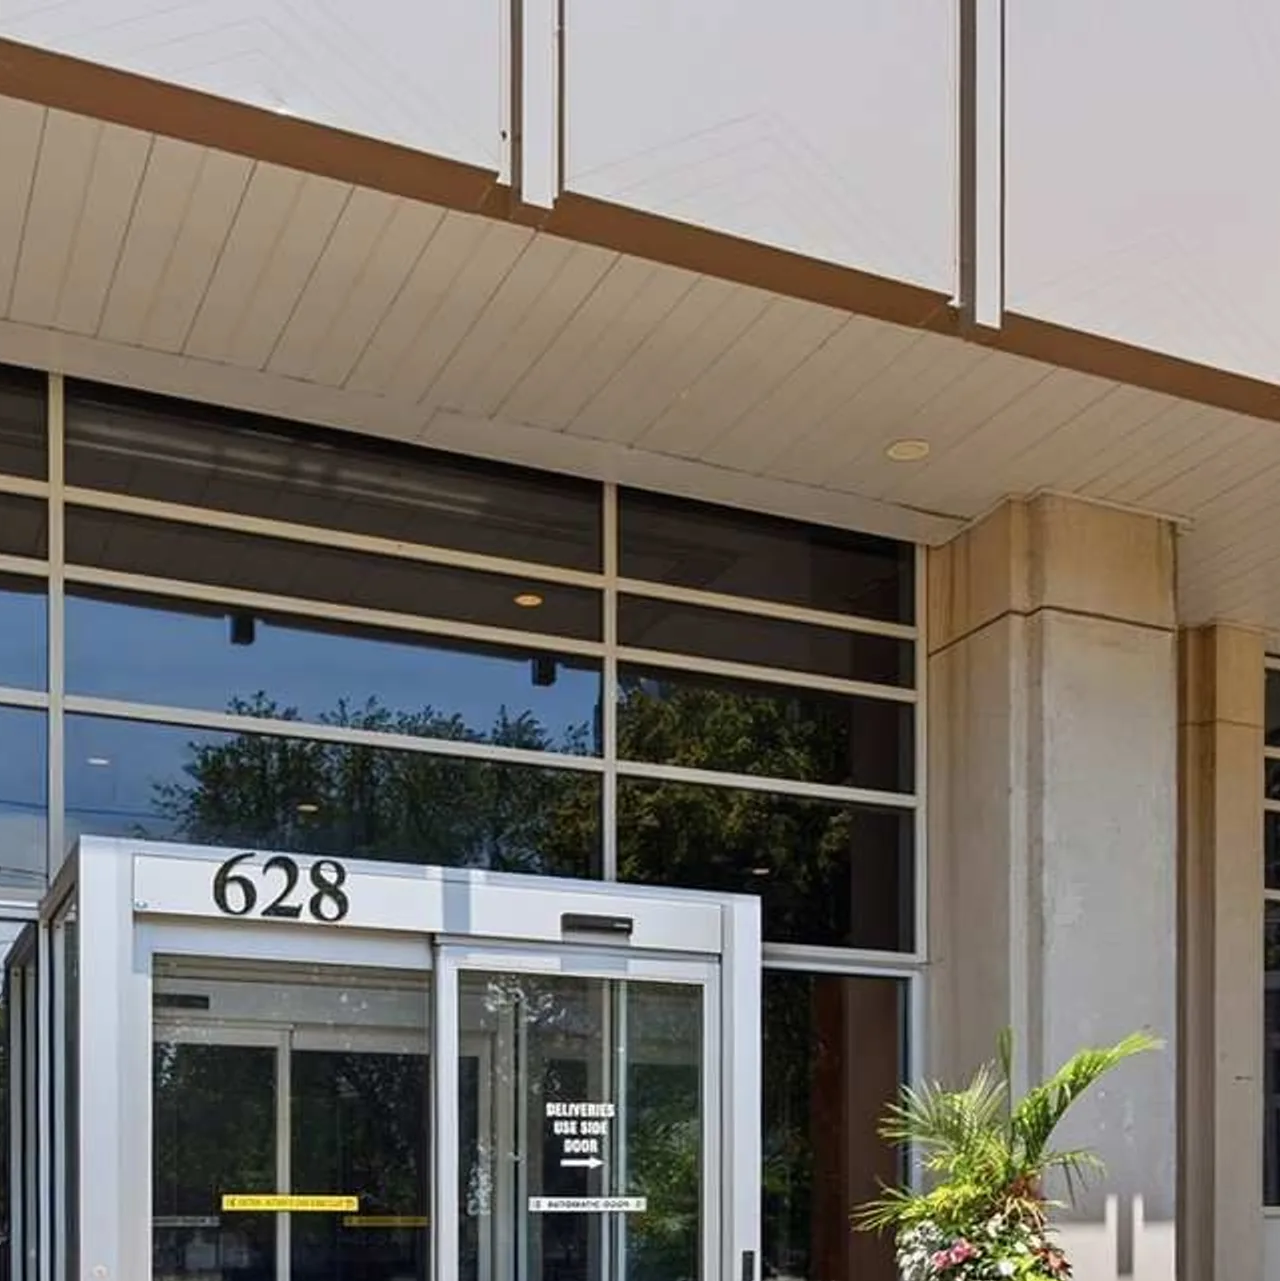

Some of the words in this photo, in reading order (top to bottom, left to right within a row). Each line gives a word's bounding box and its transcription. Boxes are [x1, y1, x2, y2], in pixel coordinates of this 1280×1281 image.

[213, 852, 349, 922] 628
[546, 1102, 615, 1117] DELIVERIES
[554, 1120, 578, 1135] USE
[580, 1120, 608, 1135] SIDE
[564, 1139, 599, 1153] DOOR
[547, 1200, 600, 1209] AUTOMATIC
